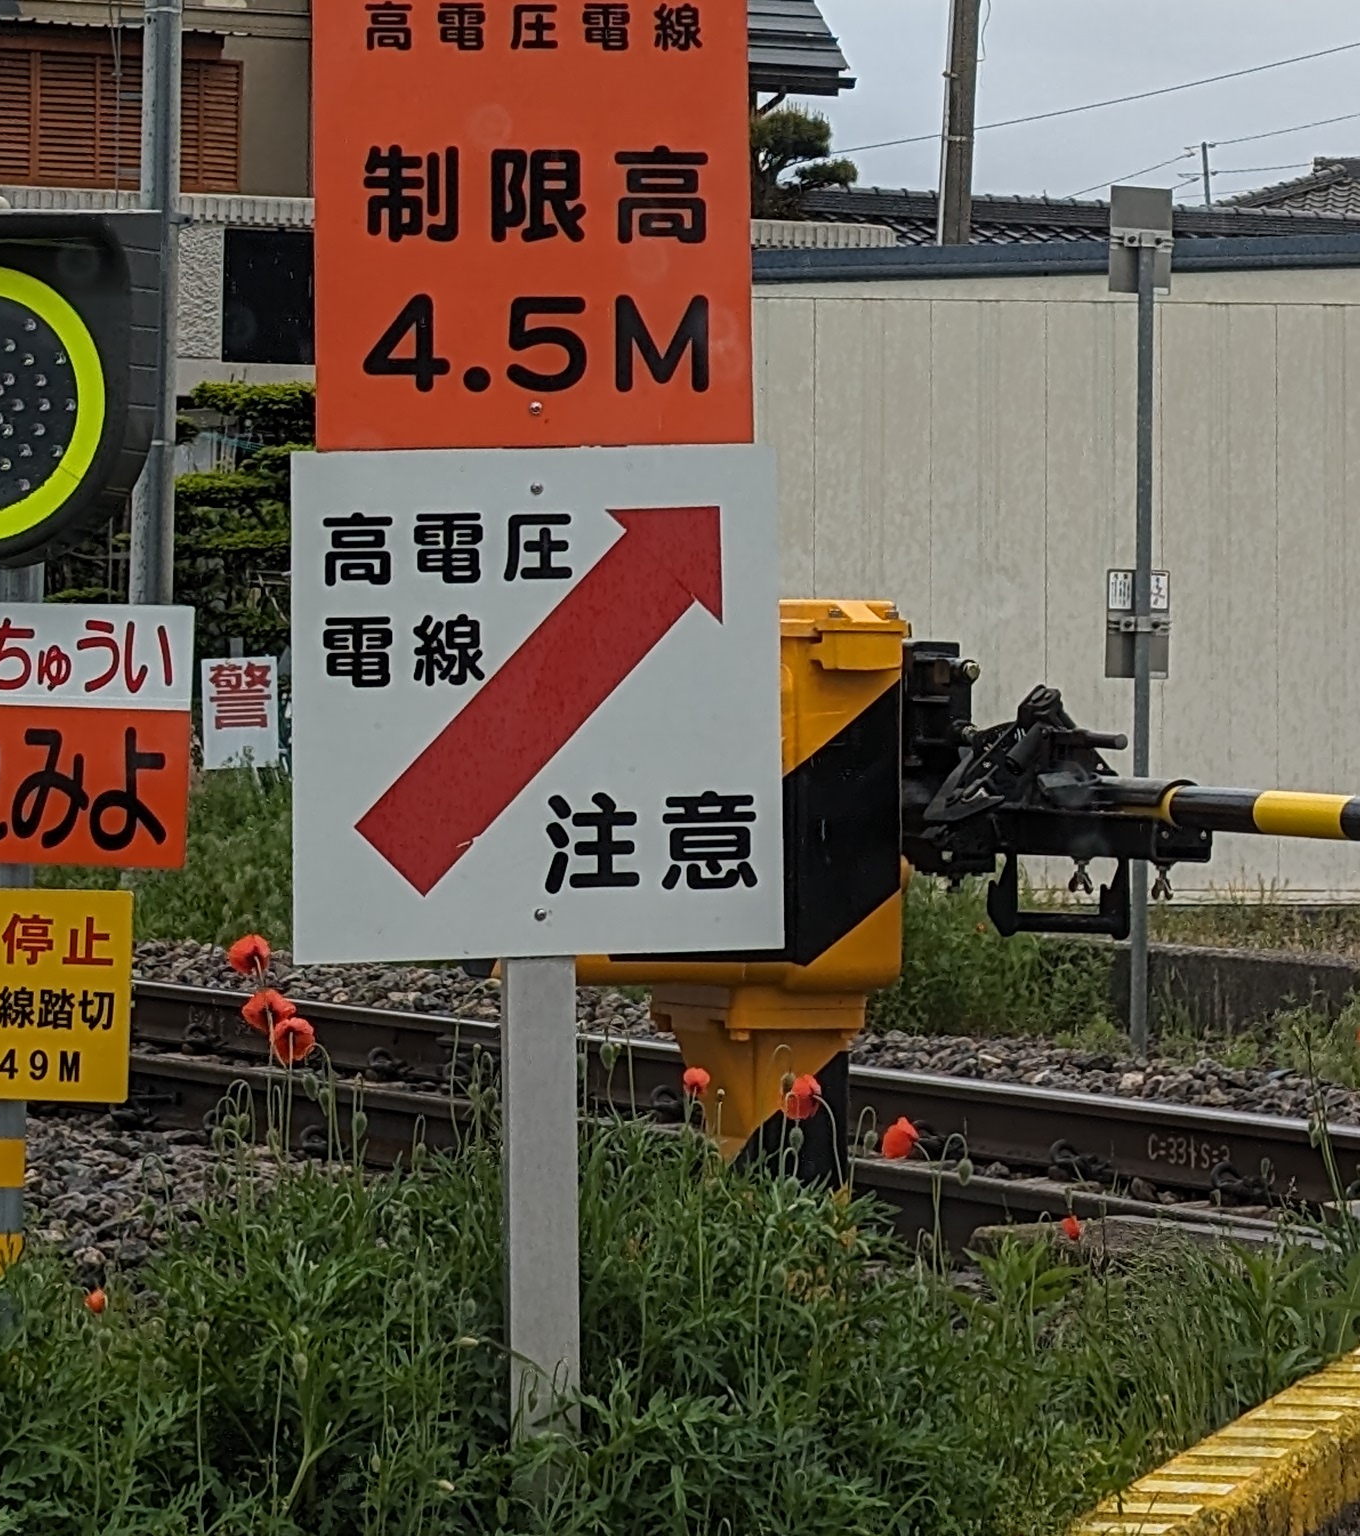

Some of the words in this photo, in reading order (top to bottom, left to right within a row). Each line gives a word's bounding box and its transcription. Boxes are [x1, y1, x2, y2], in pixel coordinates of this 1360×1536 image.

[364, 1, 703, 52] 高電圧電線
[363, 145, 709, 244] 制限高
[363, 293, 710, 394] 4.5M
[322, 512, 573, 587] 高電圧
[322, 614, 486, 687] 電線
[209, 661, 272, 730] 警
[545, 790, 759, 895] 注意
